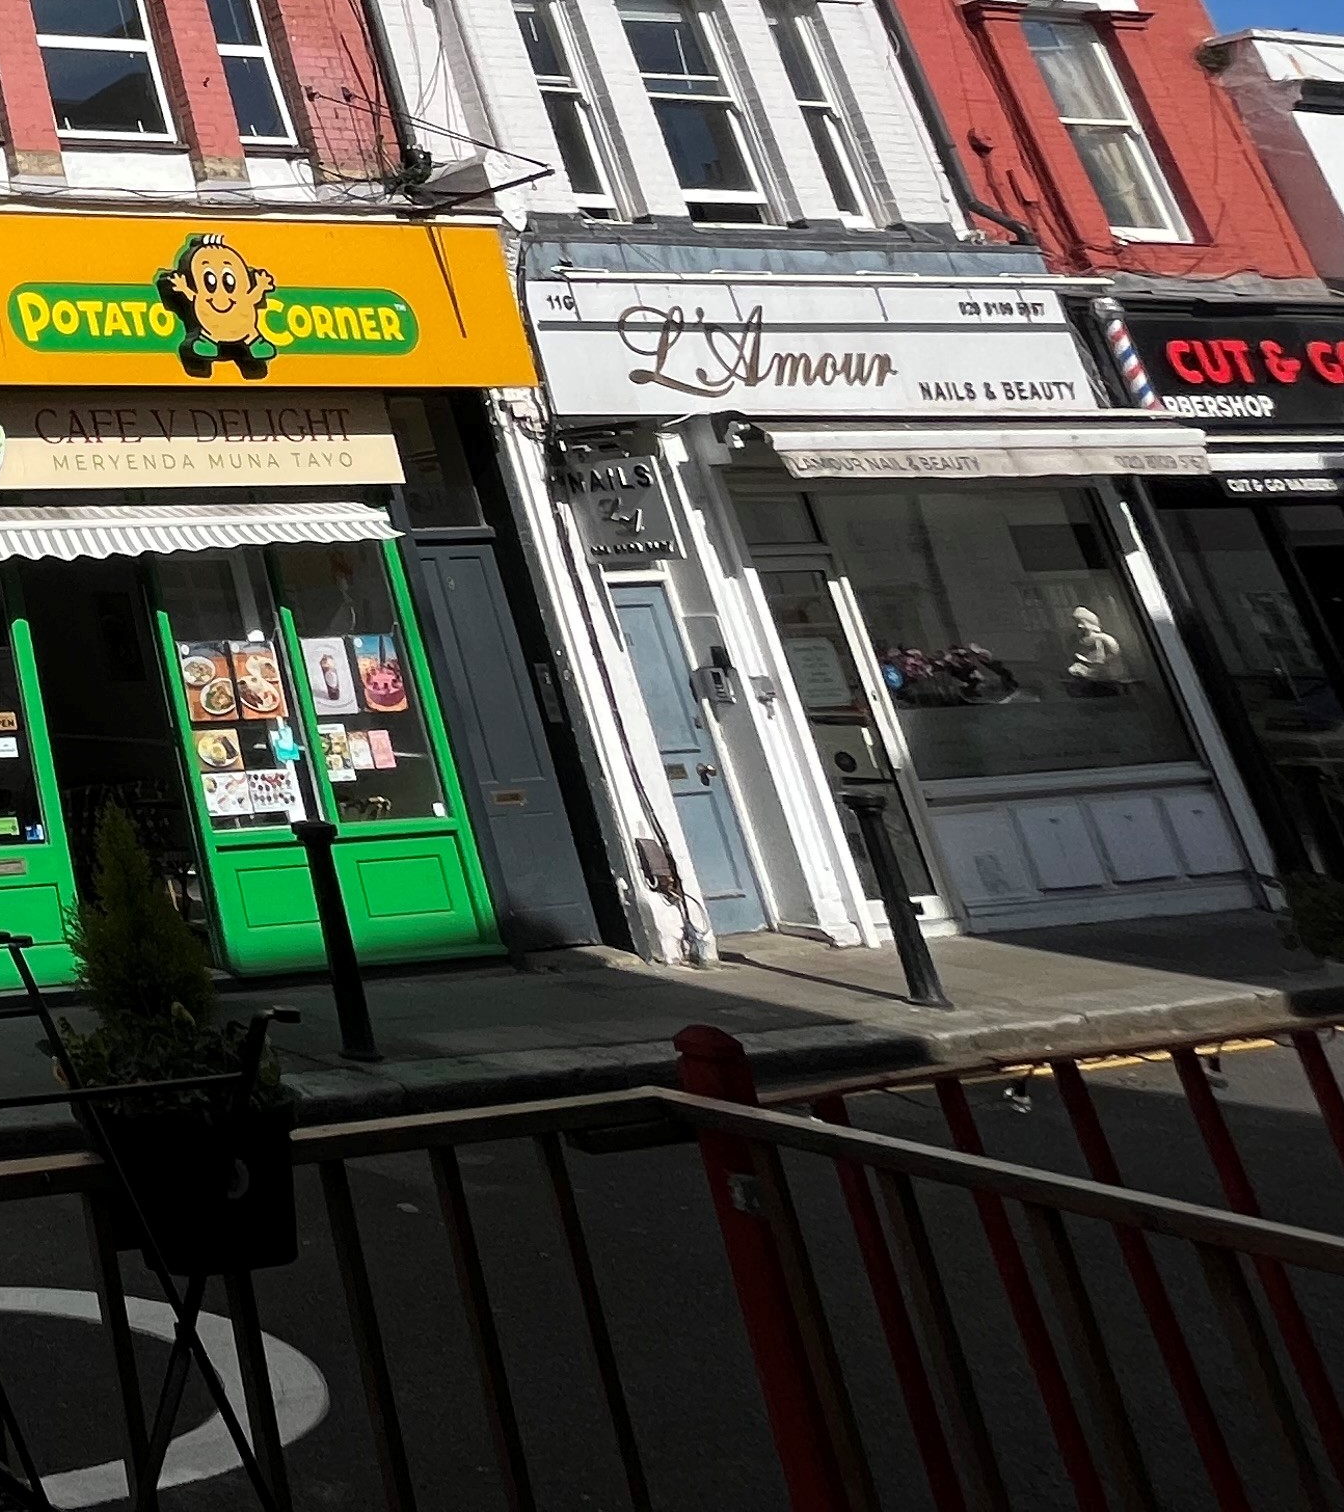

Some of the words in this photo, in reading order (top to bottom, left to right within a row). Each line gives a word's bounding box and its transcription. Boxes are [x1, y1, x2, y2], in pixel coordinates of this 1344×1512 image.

[16, 291, 175, 342] POTATO
[258, 298, 405, 346] CORNER
[1166, 339, 1257, 384] CUT
[1259, 340, 1302, 384] &
[1305, 340, 1344, 384] G
[918, 381, 977, 401] NAILS
[983, 381, 997, 401] &
[1000, 381, 1076, 401] BEAUTY
[1163, 395, 1276, 419] RBERSHOP
[33, 408, 142, 445] CAFE
[150, 408, 174, 443] V
[191, 408, 352, 443] DELIGHT
[53, 452, 196, 472] MERYENDA
[209, 452, 280, 470] MUNA
[291, 451, 354, 469] TAYO
